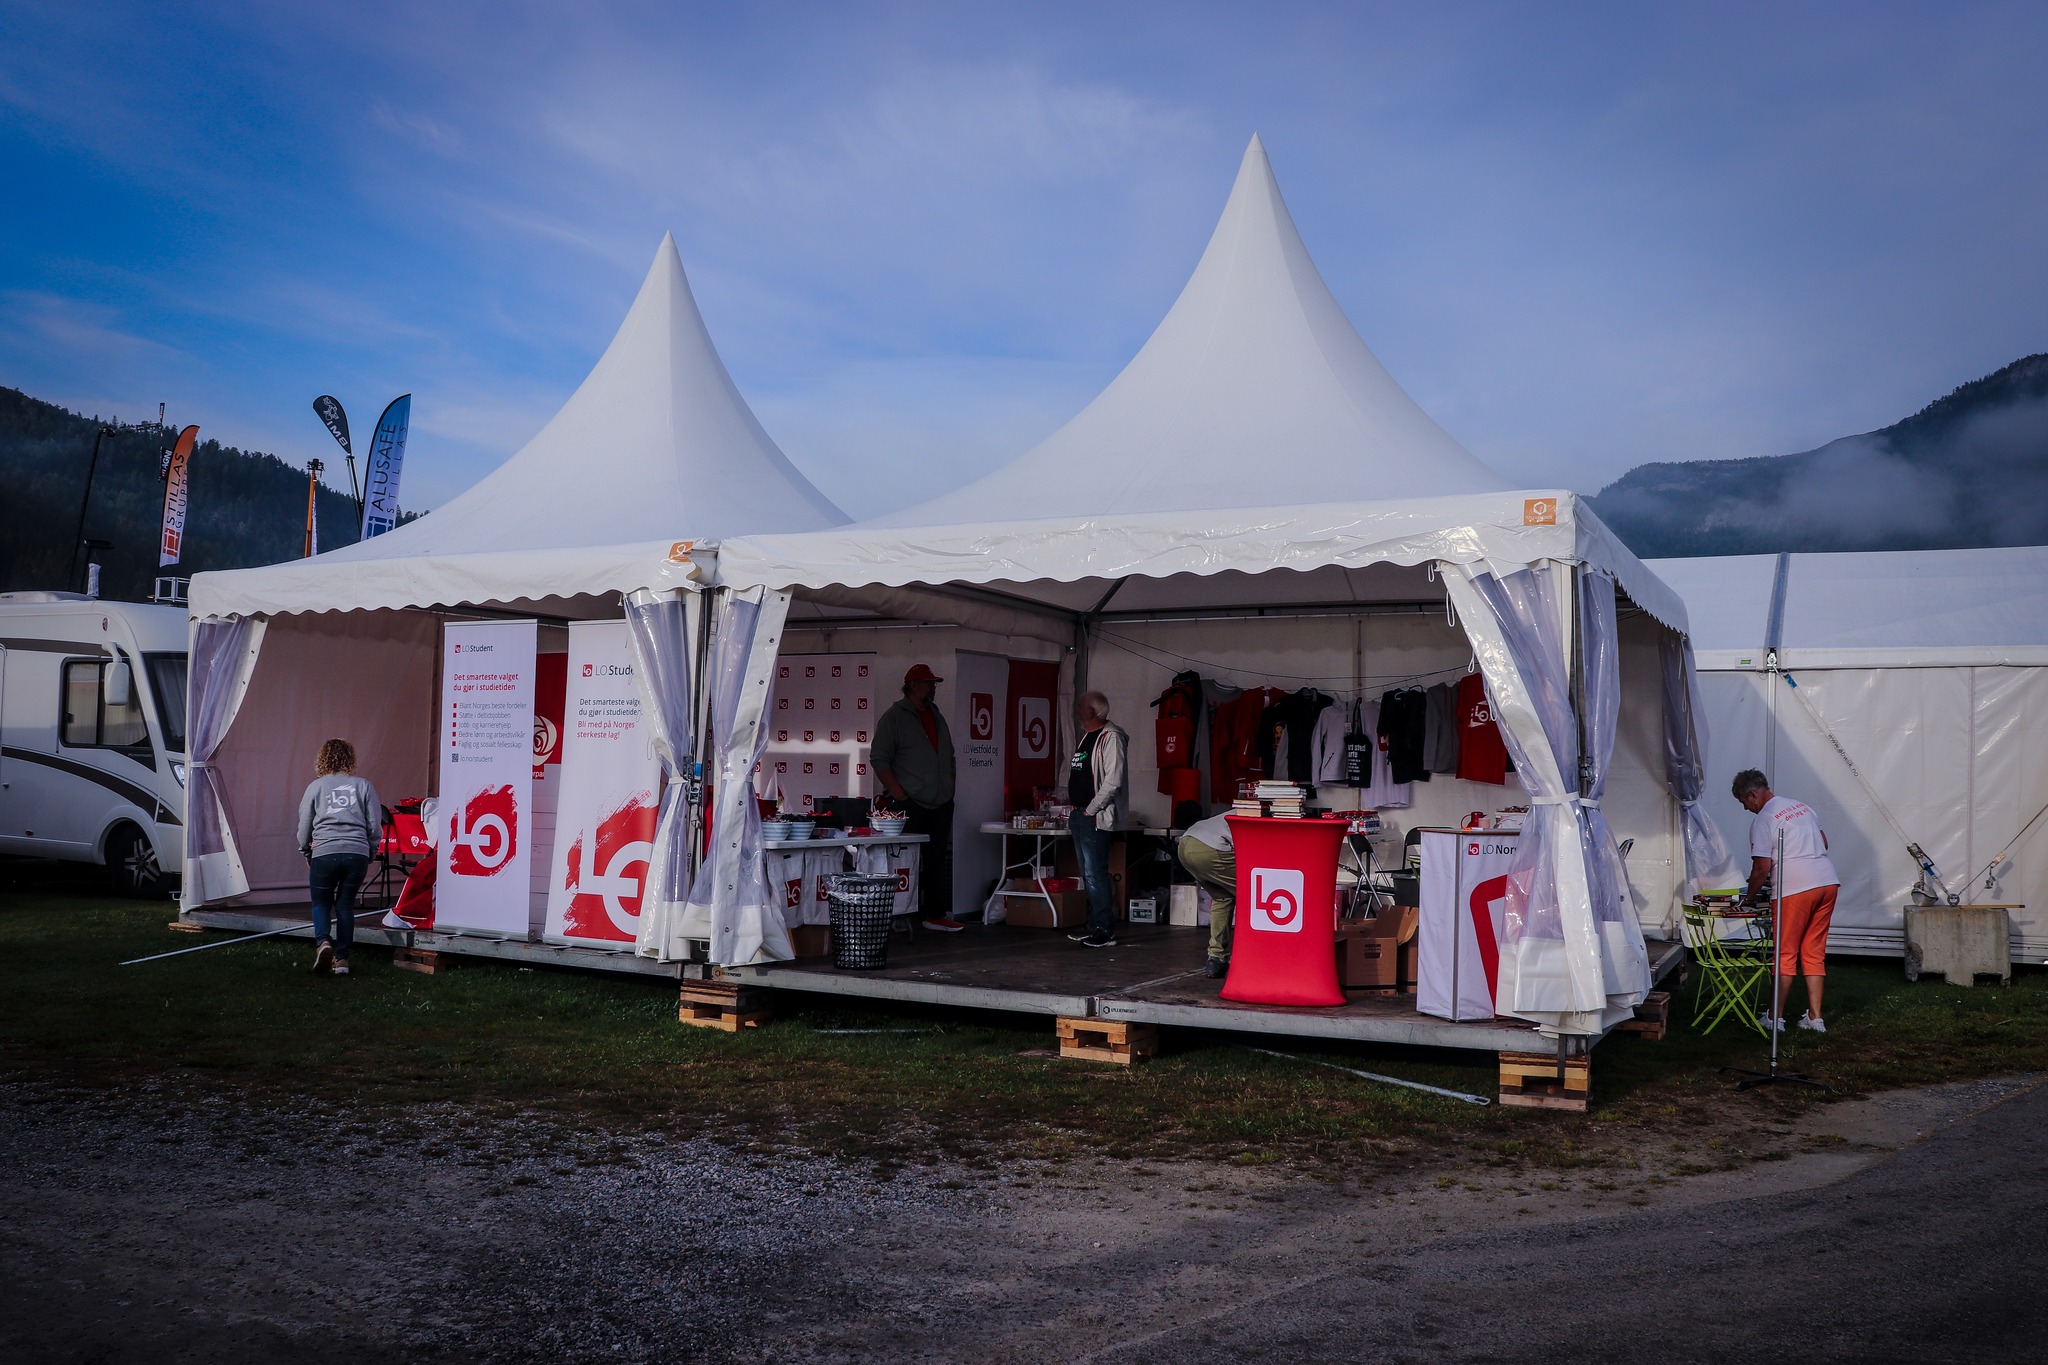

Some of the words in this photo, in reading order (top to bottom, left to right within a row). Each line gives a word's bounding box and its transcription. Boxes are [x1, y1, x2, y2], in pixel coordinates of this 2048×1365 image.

[371, 424, 396, 512] ALUSAFE
[387, 425, 406, 514] STILLAS
[167, 452, 185, 526] STILLAS
[499, 673, 518, 682] valget
[463, 684, 474, 692] gjør
[589, 709, 601, 717] gjør
[604, 720, 611, 729] på
[613, 721, 635, 730] Norges
[608, 731, 620, 740] lag!
[969, 758, 993, 767] Telemark
[1483, 845, 1494, 854] LO
